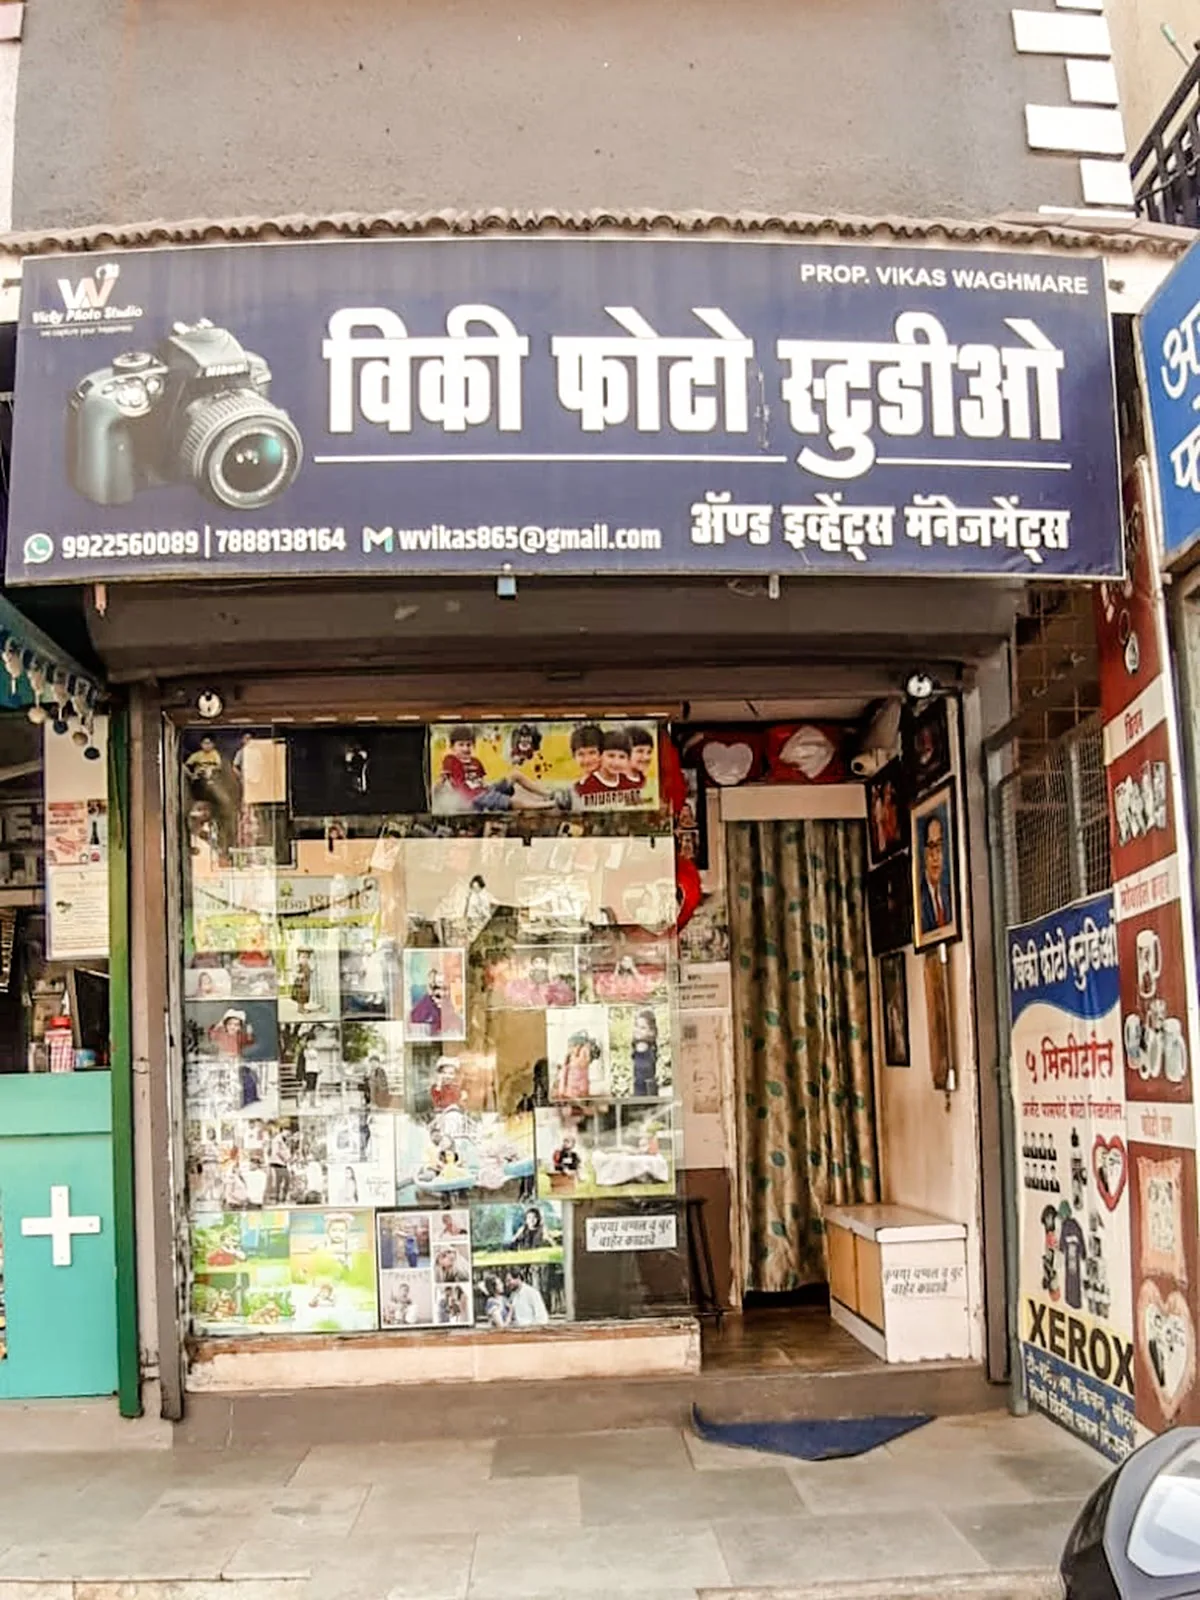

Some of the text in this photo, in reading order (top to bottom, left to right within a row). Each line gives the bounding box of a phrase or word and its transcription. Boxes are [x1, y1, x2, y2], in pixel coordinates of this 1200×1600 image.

[800, 264, 1089, 295] PROP. VIKAS WAGHMARE
[104, 305, 143, 320] Studio
[321, 303, 1065, 480] विकी फोटो स्टुडीओ
[62, 527, 346, 559] 9922560089 7888138164
[399, 523, 662, 553] wvikas865@gmail.com
[781, 491, 896, 561] इव्हेंट्स
[904, 493, 1070, 563] मॅनेजमेंट्स
[1040, 928, 1068, 985] फोटो
[1027, 1298, 1135, 1396] XEROX
